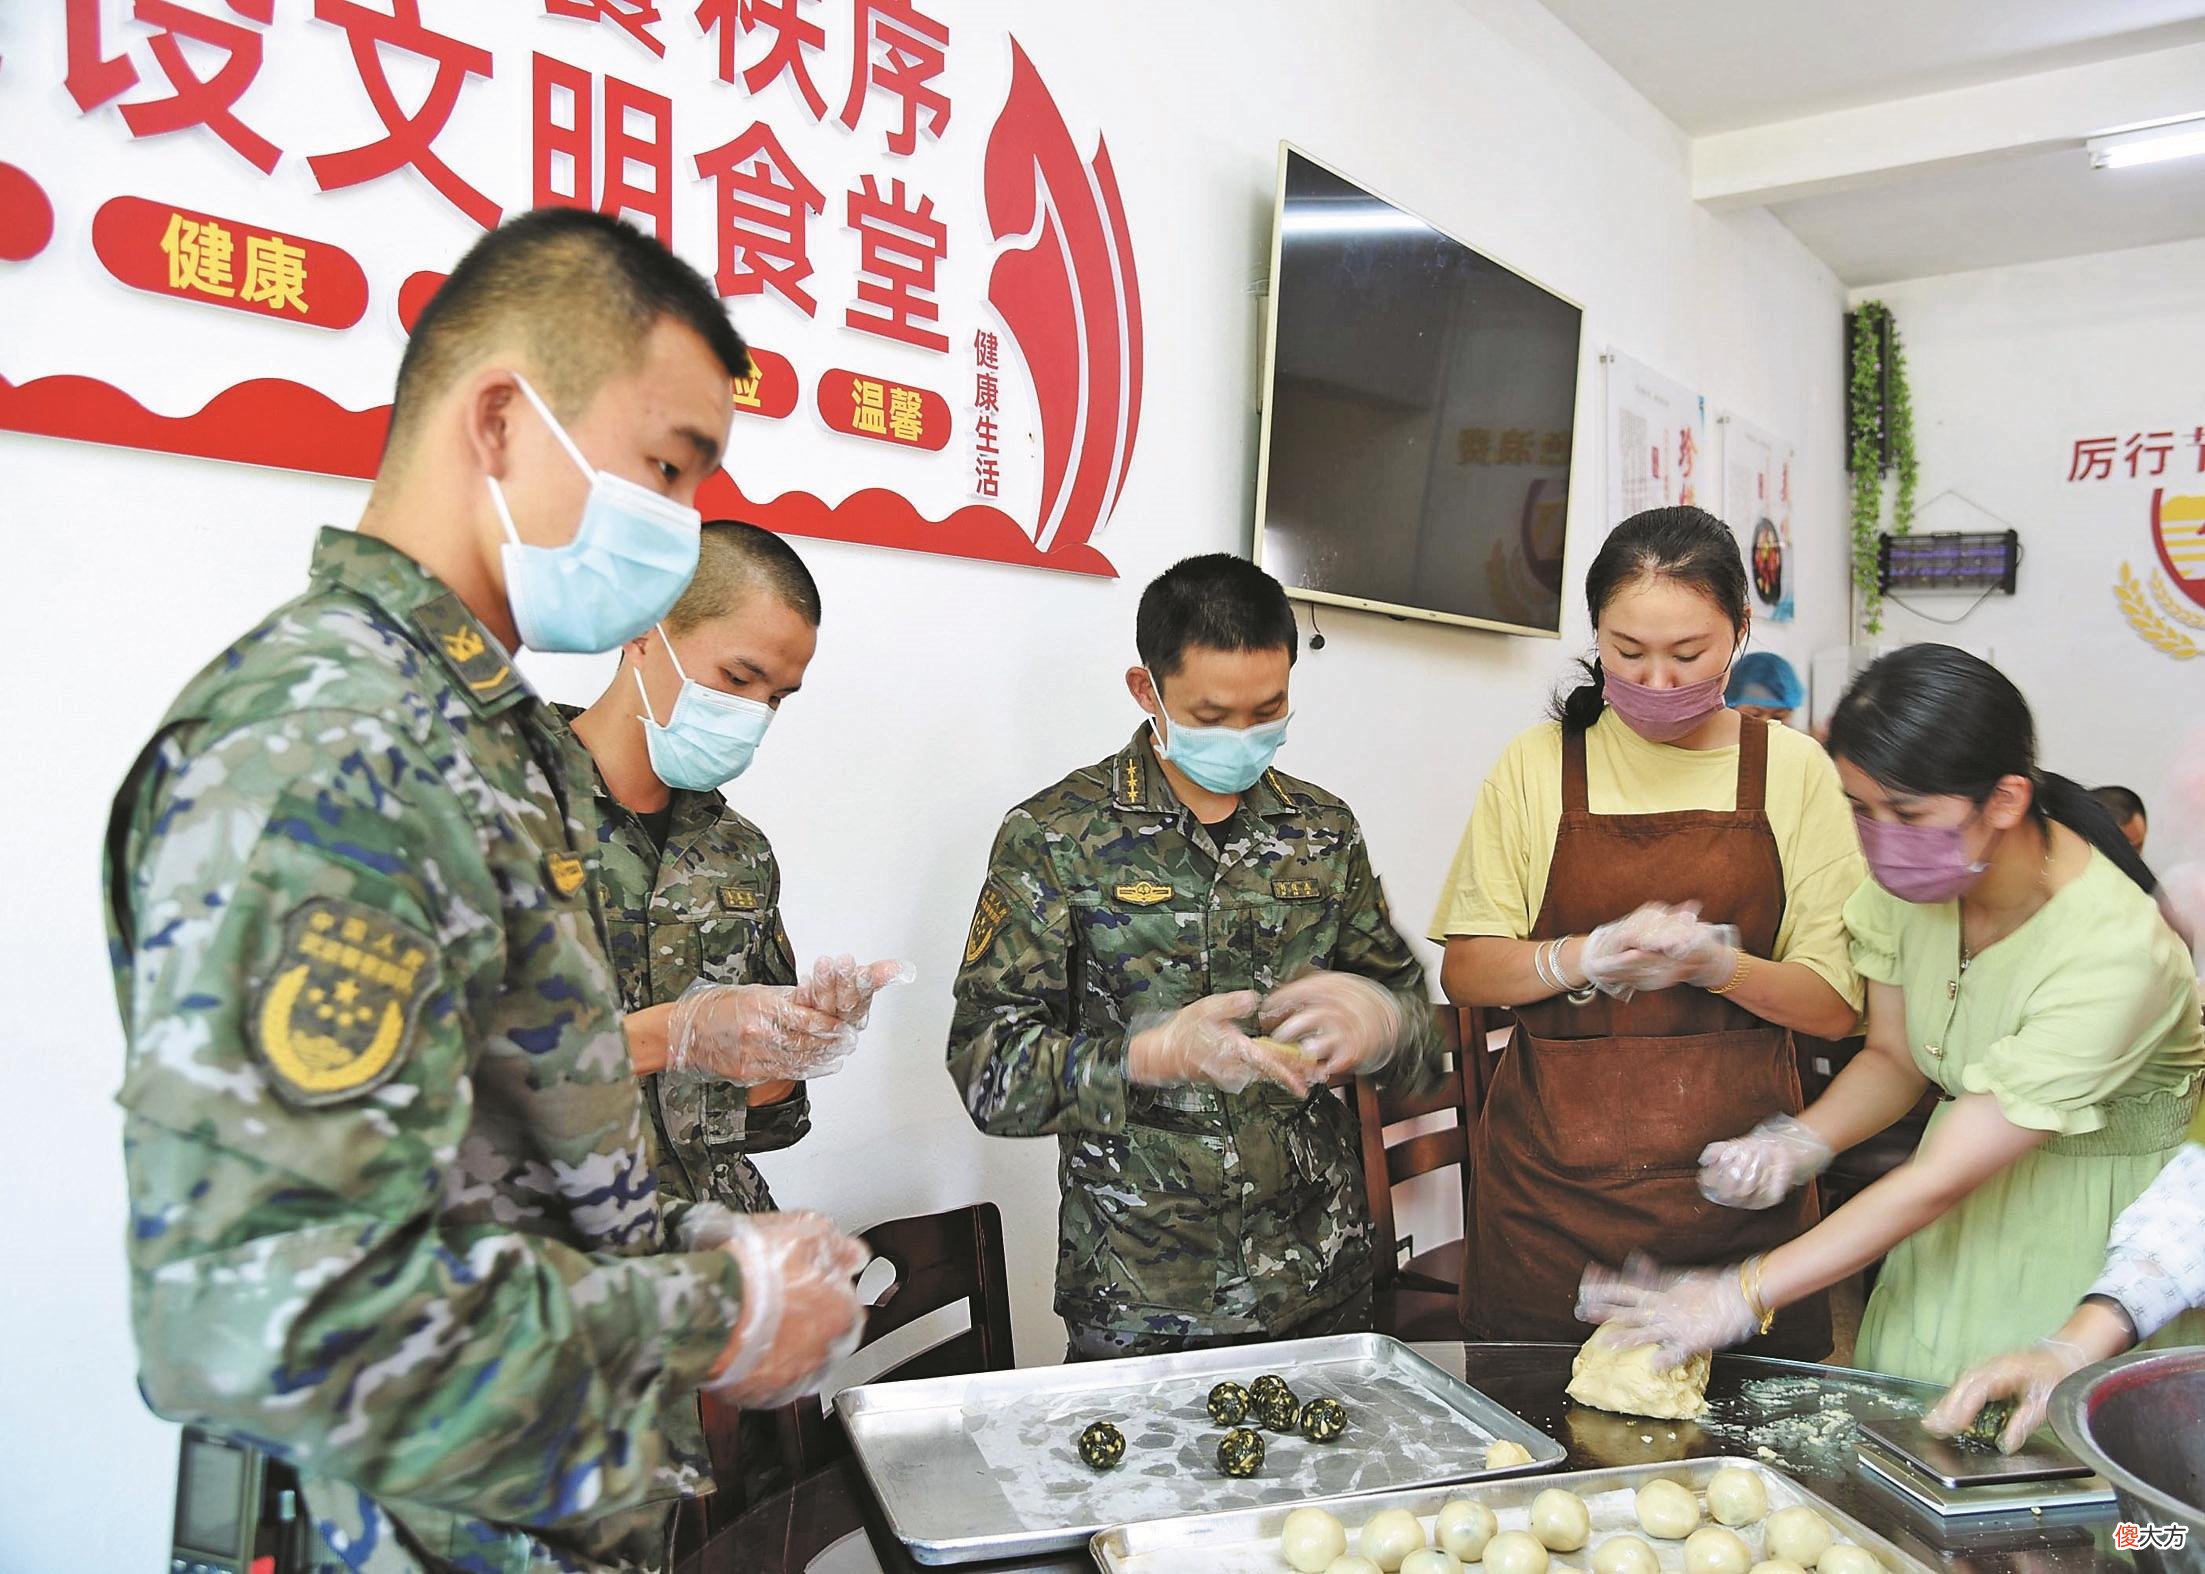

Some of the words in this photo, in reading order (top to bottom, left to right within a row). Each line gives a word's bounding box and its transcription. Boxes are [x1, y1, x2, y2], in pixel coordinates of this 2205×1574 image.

[160, 213, 309, 314] 健康
[851, 378, 923, 441] 温馨
[974, 327, 1000, 497] 健康生活
